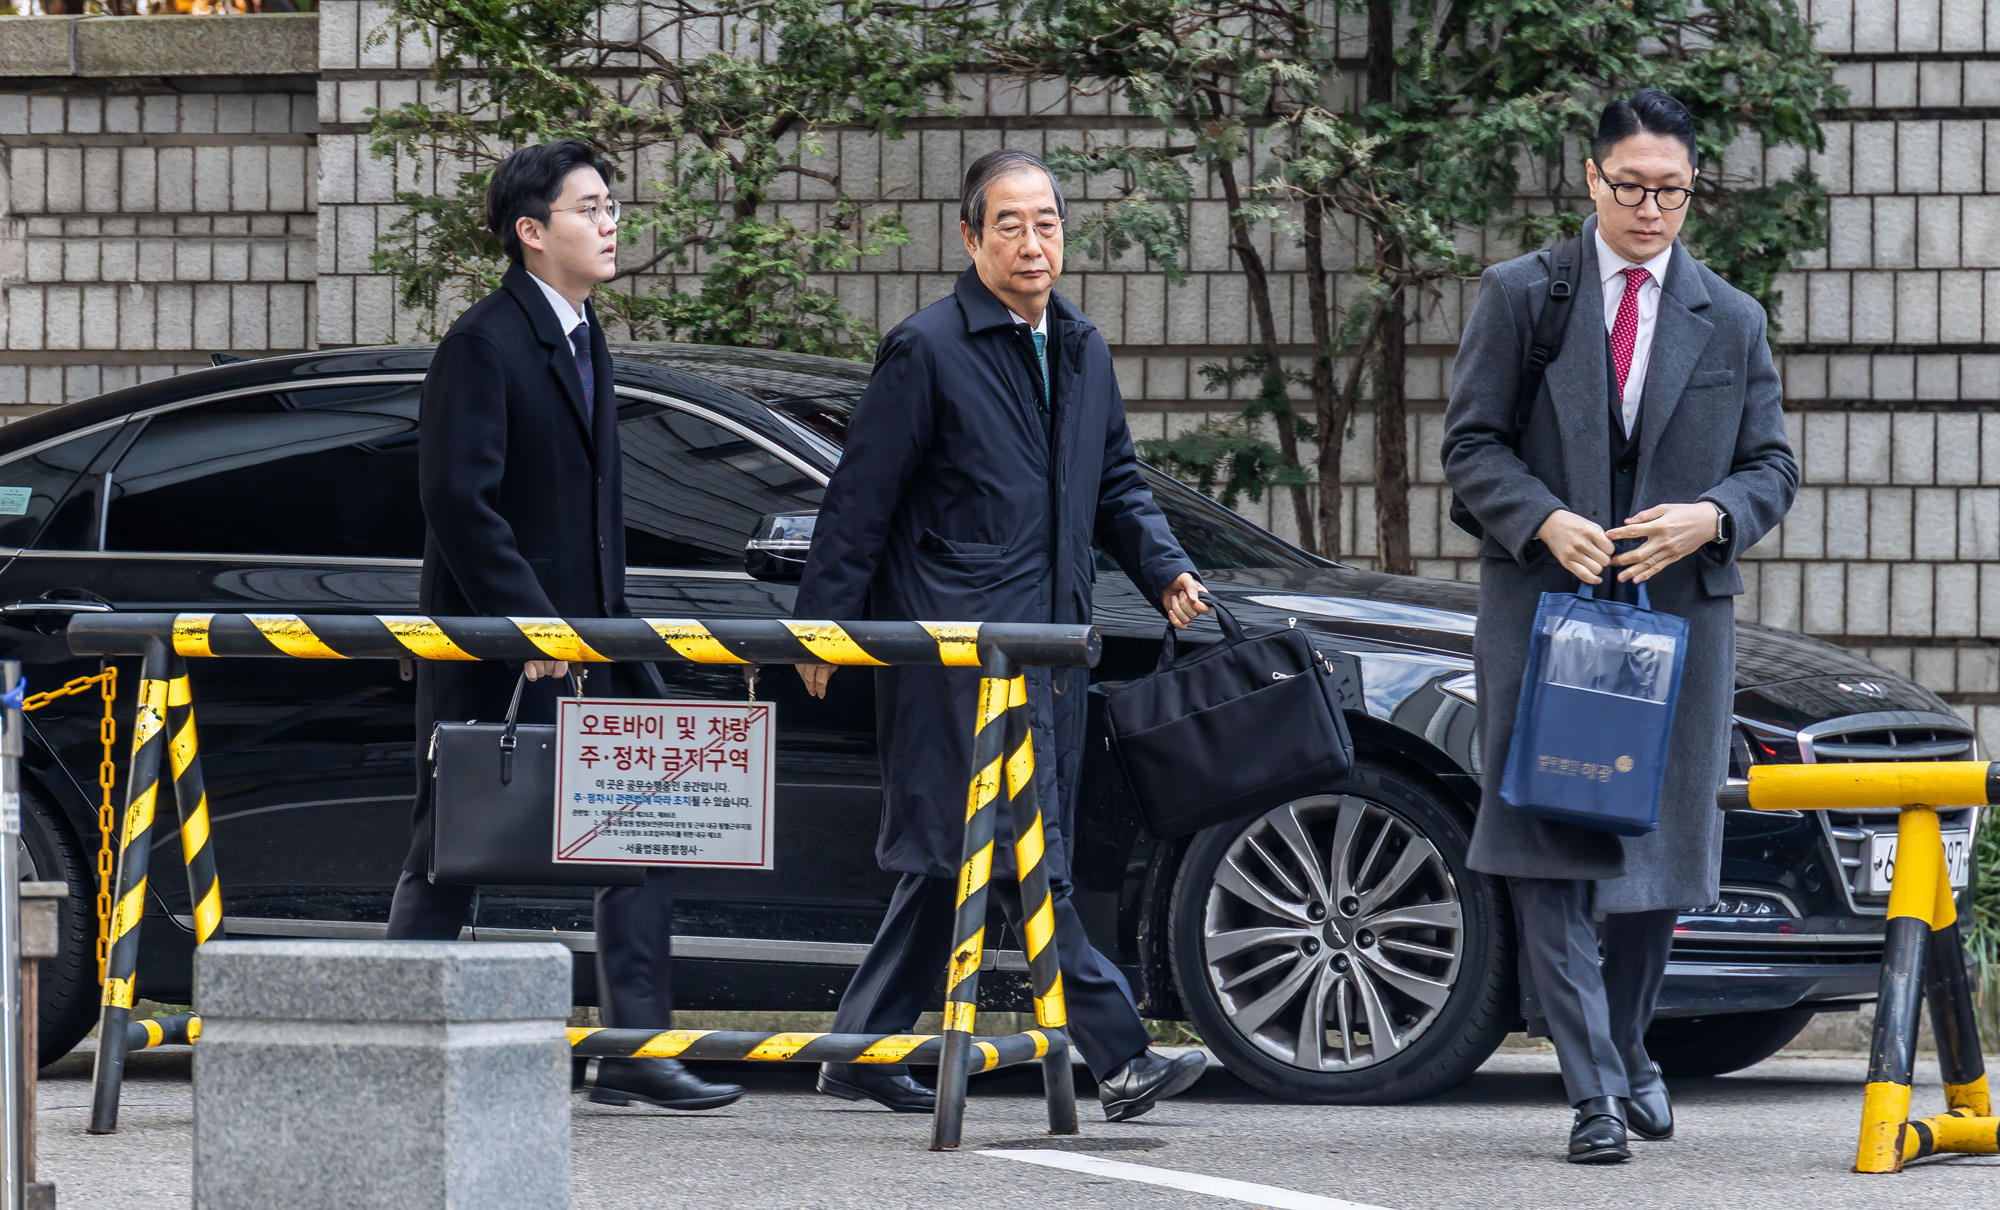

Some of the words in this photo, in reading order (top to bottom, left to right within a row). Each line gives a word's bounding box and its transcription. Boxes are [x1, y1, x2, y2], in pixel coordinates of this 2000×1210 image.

[579, 714, 664, 740] 오토바이
[676, 716, 696, 740] 및
[707, 717, 751, 743] 차량
[579, 745, 656, 771] 주·정차
[661, 747, 749, 773] 금지구역
[595, 779, 605, 790] 이
[606, 779, 625, 791] 곳은
[627, 779, 680, 792] 공무수행중인
[682, 781, 731, 793] 공간입니다.
[615, 793, 652, 805] 관련법에
[652, 794, 672, 806] 따라
[672, 795, 701, 807] 조치될
[701, 796, 712, 807] 수
[713, 796, 753, 808] 있습니다.
